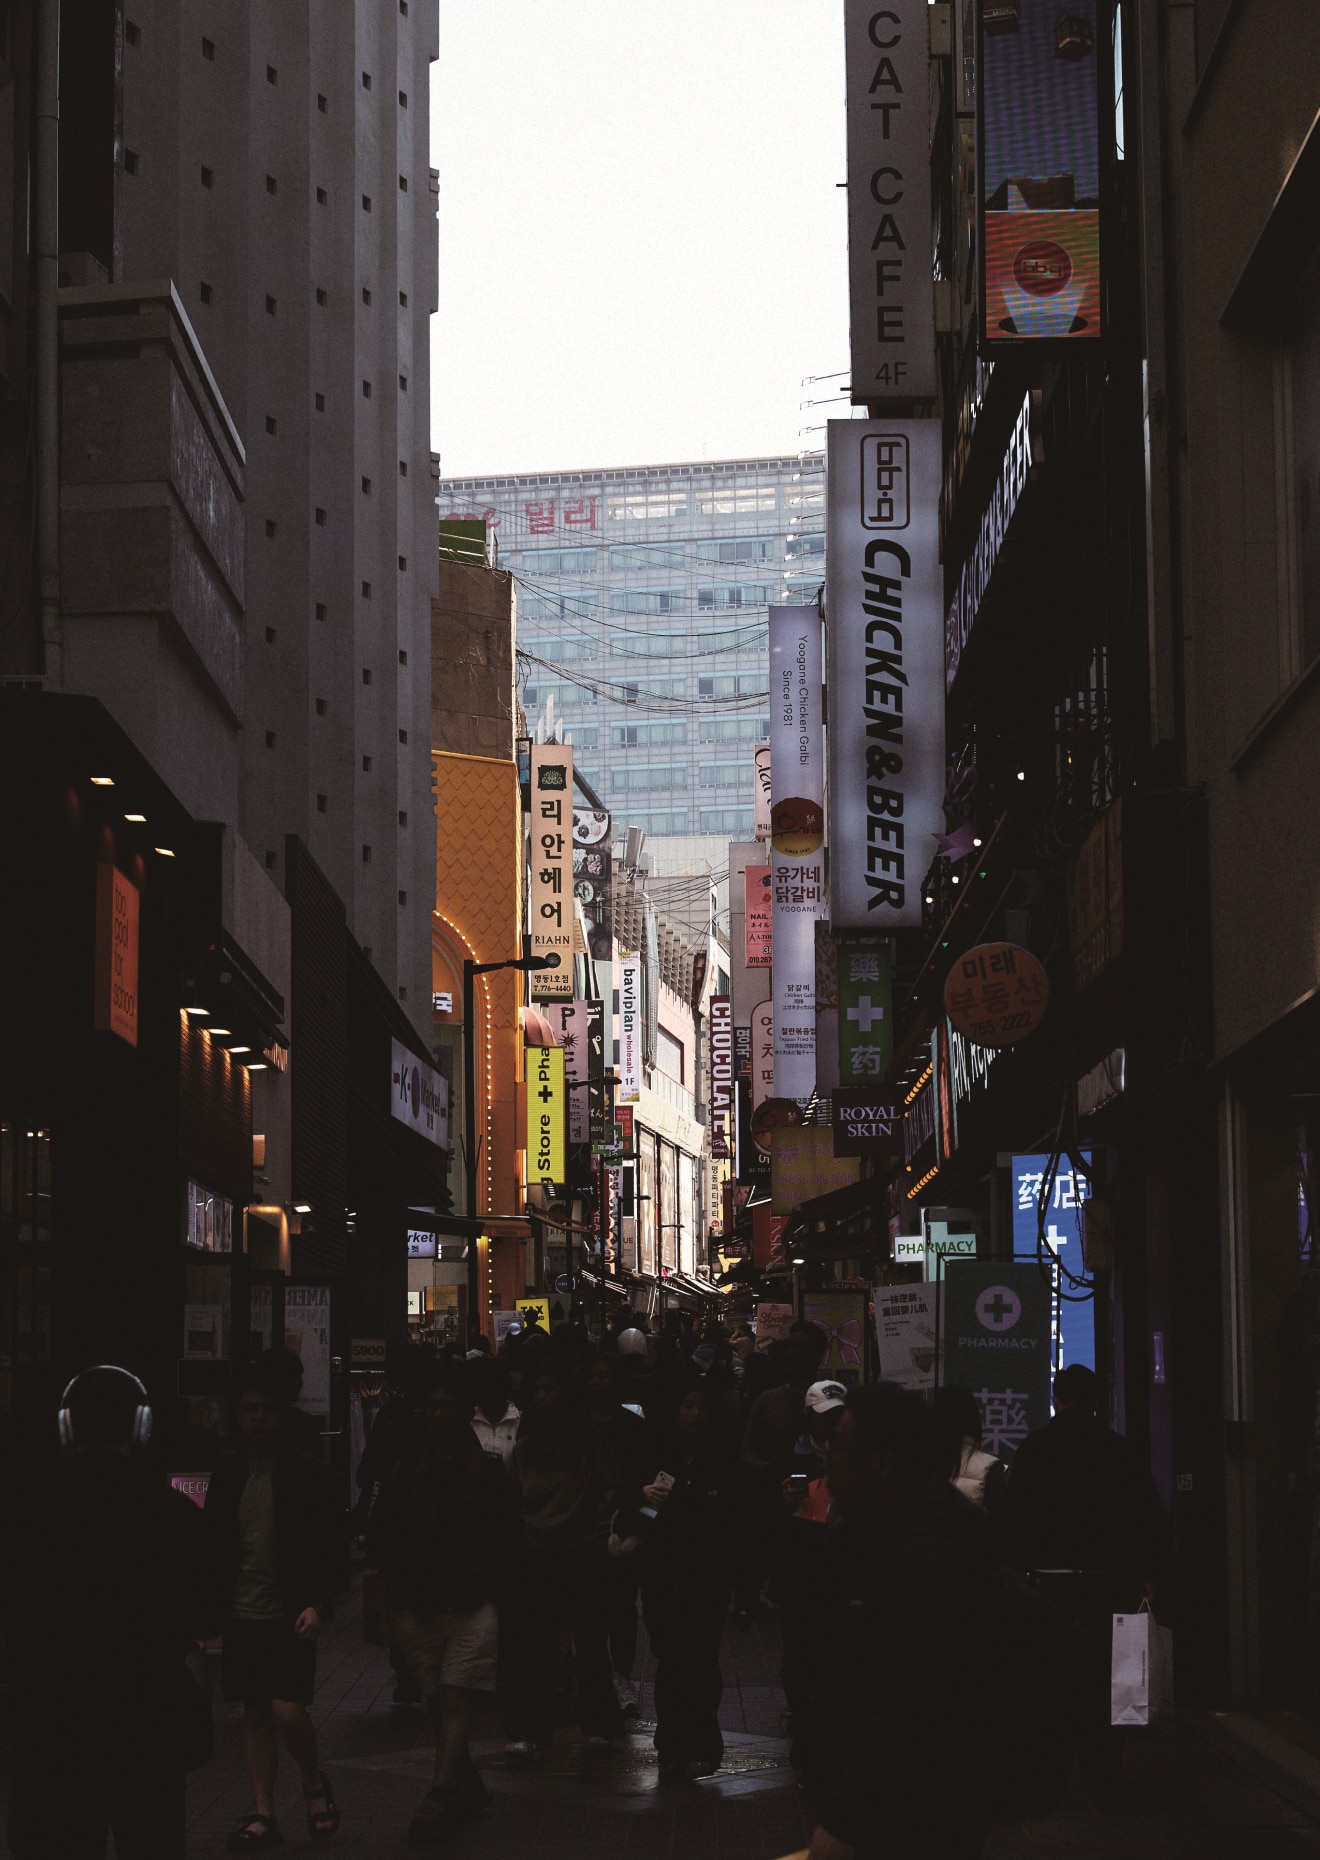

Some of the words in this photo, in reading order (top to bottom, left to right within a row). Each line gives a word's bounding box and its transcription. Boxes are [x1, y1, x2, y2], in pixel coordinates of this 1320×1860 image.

[868, 11, 903, 139] CAT
[870, 167, 906, 342] CAFE
[875, 363, 907, 385] 4F
[797, 635, 808, 684] Yoogane
[782, 670, 792, 699] Since
[783, 703, 793, 726] 1981
[799, 687, 808, 732] Chicken
[799, 735, 809, 765] Galbi
[540, 800, 565, 927] 리안헤어
[776, 866, 820, 883] 유가네
[776, 886, 820, 903] 닭갈비
[535, 935, 570, 945] RIAHN
[850, 953, 880, 982] 藥
[962, 949, 1017, 980] 미래
[623, 969, 636, 1033] baviplan
[950, 973, 1043, 1019] 부동산
[970, 1011, 1034, 1037] 755-2222
[626, 1034, 634, 1074] wholesale
[850, 1047, 881, 1076] 药
[625, 1078, 634, 1086] 1F
[839, 1105, 900, 1121] ROYAL
[538, 1114, 550, 1171] Store
[847, 1123, 893, 1137] SKIN
[1018, 1170, 1087, 1210] 药店
[407, 1231, 434, 1243] rket
[898, 1240, 974, 1255] PHARMACY
[353, 1346, 385, 1355] 5900
[958, 1336, 1038, 1349] PHARMACY
